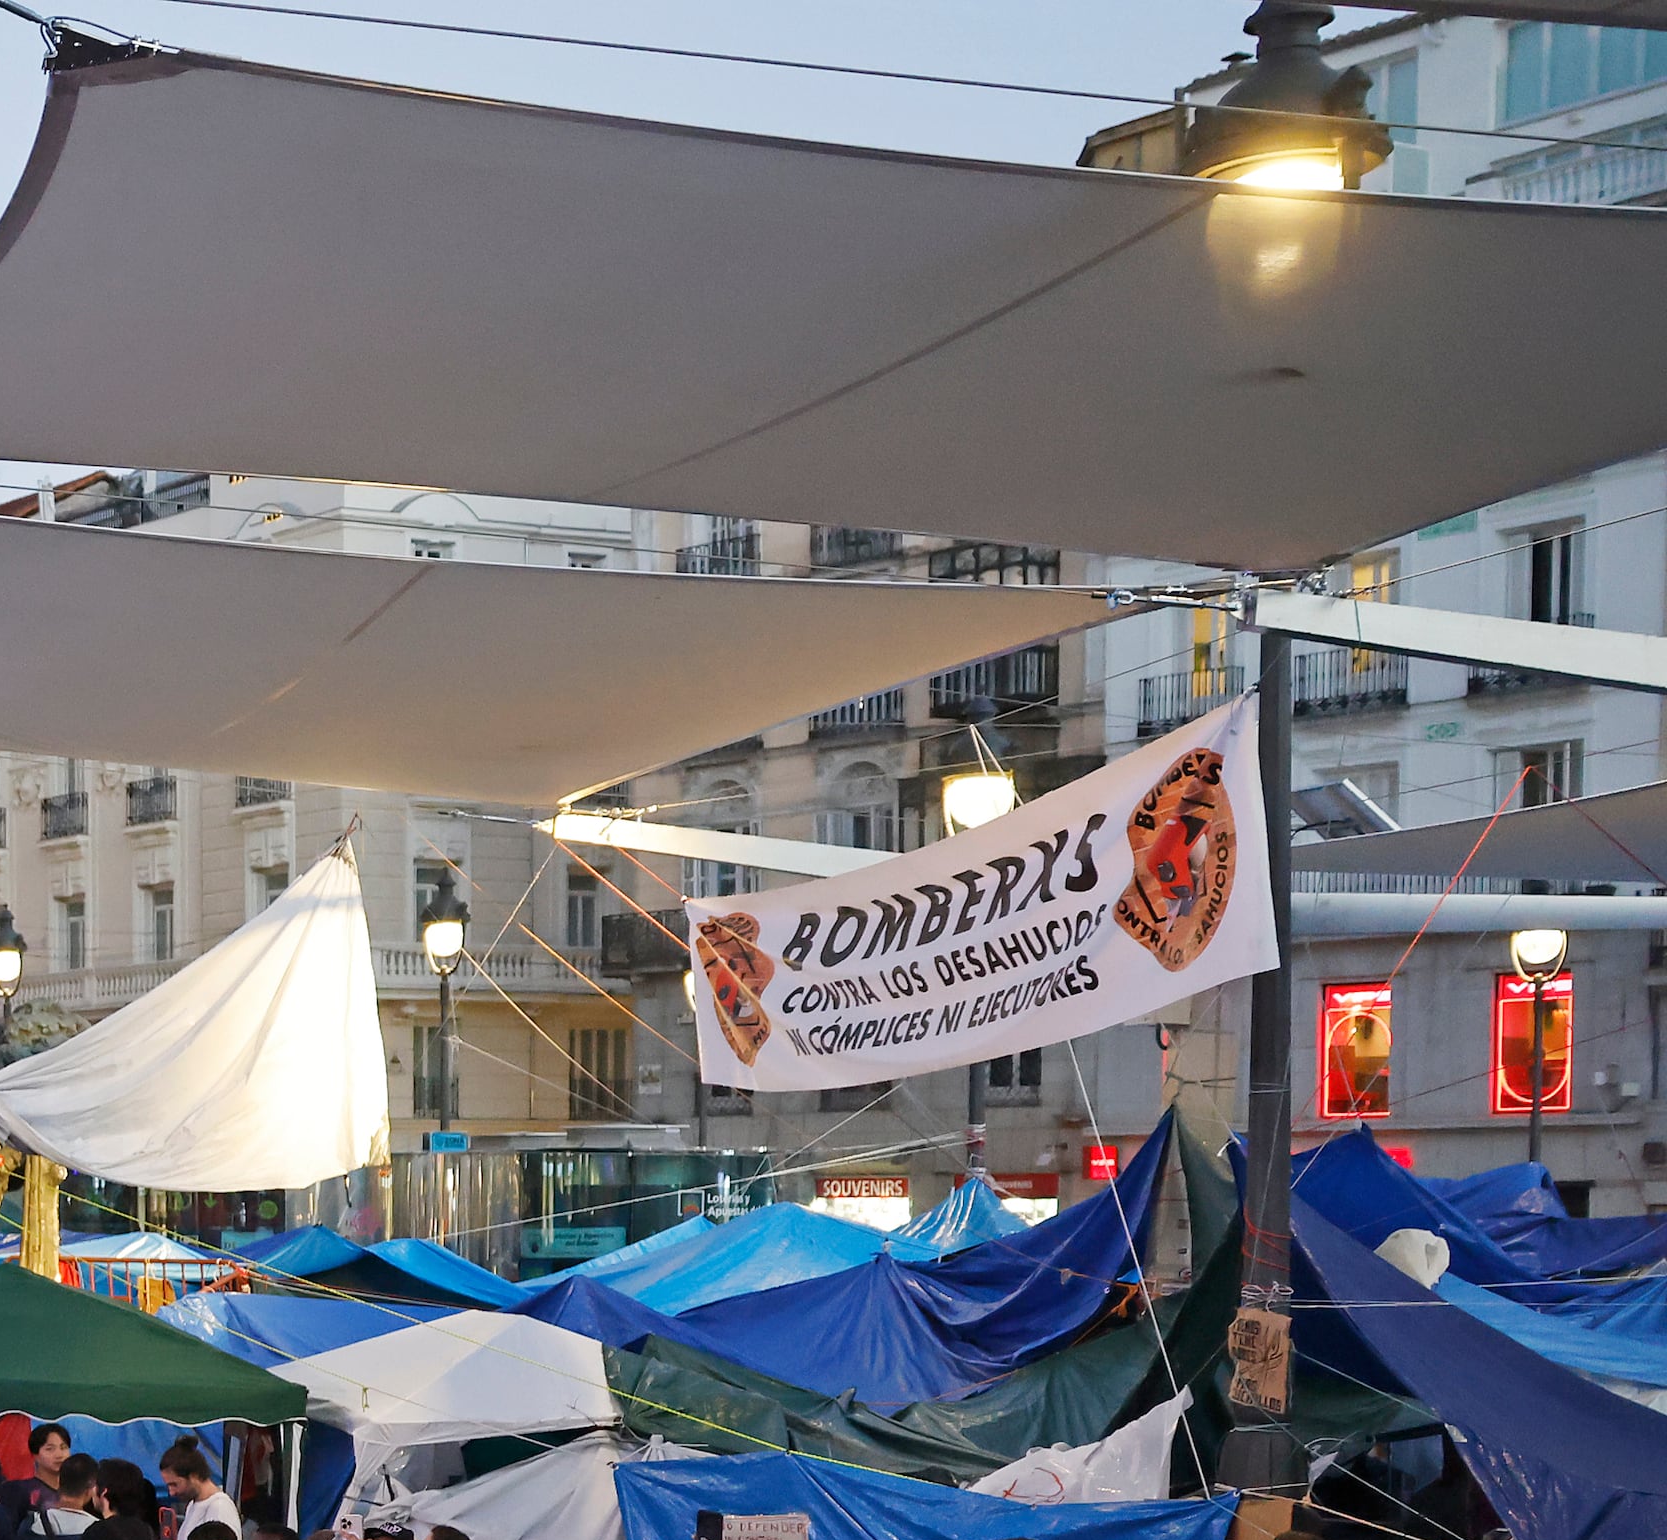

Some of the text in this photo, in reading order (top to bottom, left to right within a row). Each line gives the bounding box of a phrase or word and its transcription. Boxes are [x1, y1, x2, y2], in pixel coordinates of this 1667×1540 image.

[782, 813, 1109, 972] BOMBERXS
[782, 903, 1107, 1014] CONTRA LOS DESAHUCIOS
[788, 954, 1100, 1058] NI CÓMPLICES NI EJECUTORES
[823, 1179, 903, 1197] SOUVENIRS
